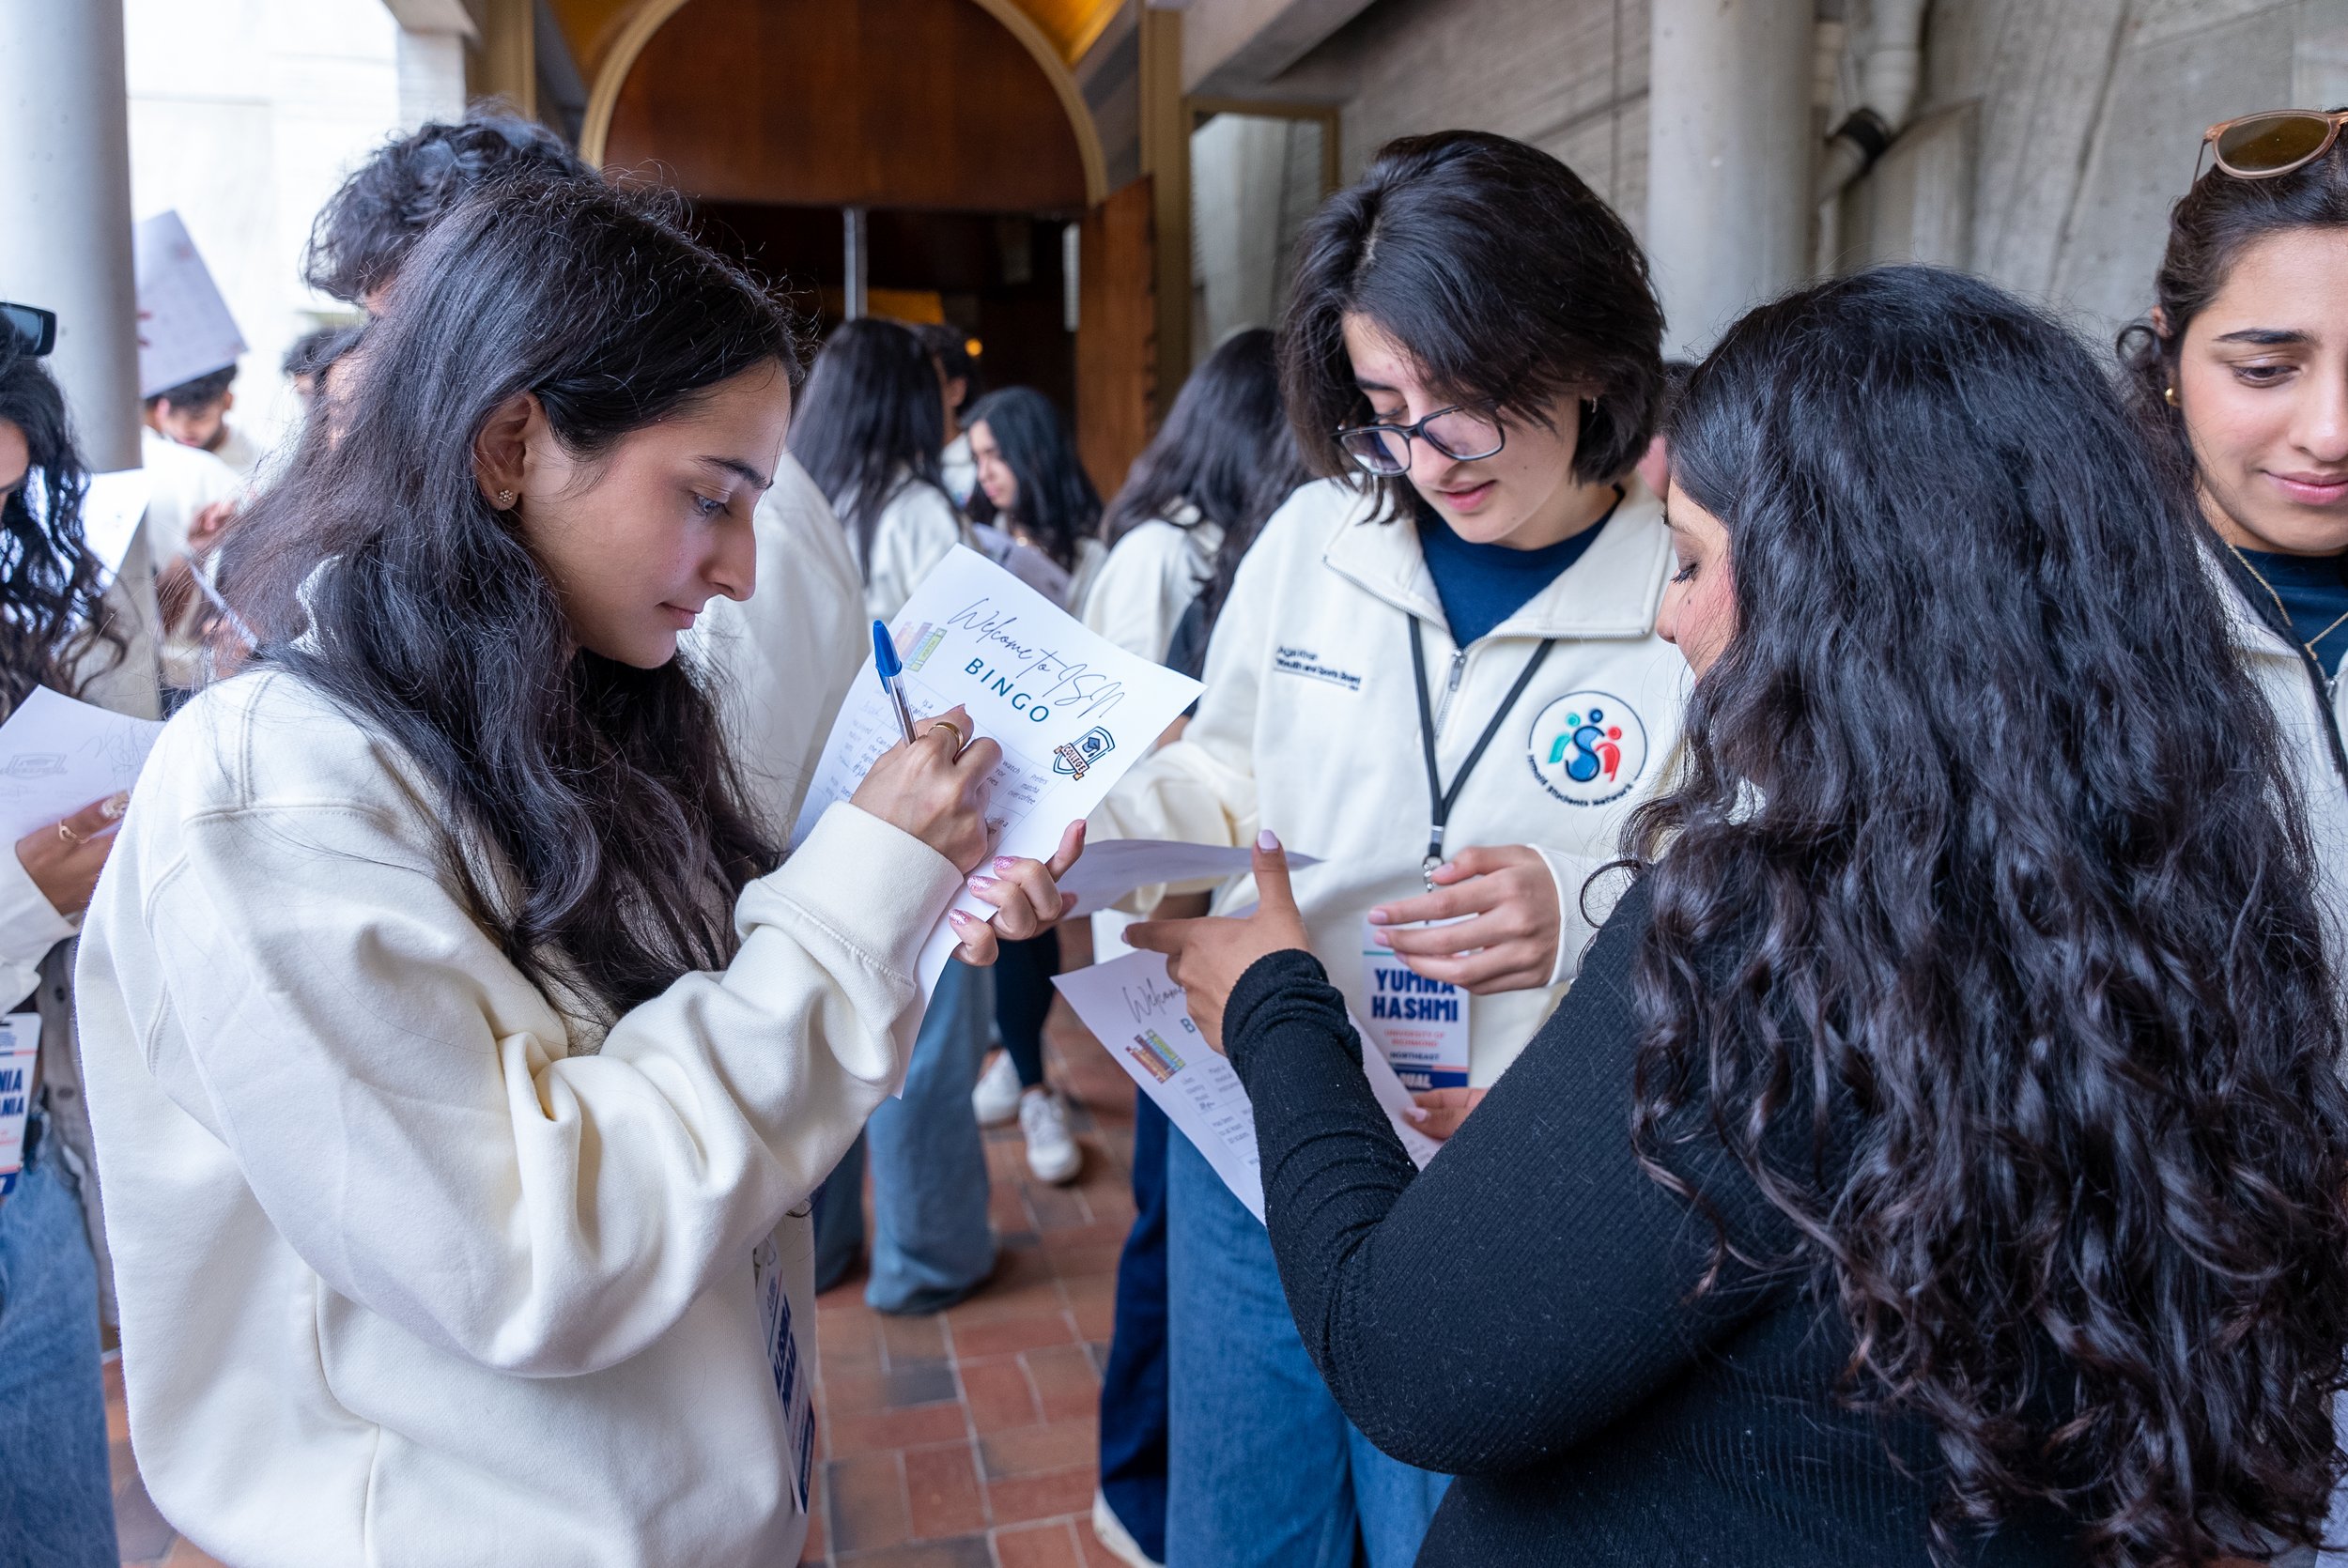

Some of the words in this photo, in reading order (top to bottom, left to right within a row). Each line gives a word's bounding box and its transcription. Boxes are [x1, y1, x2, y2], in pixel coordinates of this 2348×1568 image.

[947, 597, 1033, 659] Welcome
[1015, 648, 1068, 679] to
[965, 657, 1050, 723] BINGO
[1002, 760, 1021, 775] watch
[1063, 745, 1087, 774] COLLEGE
[1375, 968, 1456, 995] YUMNA
[1372, 995, 1459, 1023] HASHMI
[1390, 1051, 1441, 1061] NORTHEAST
